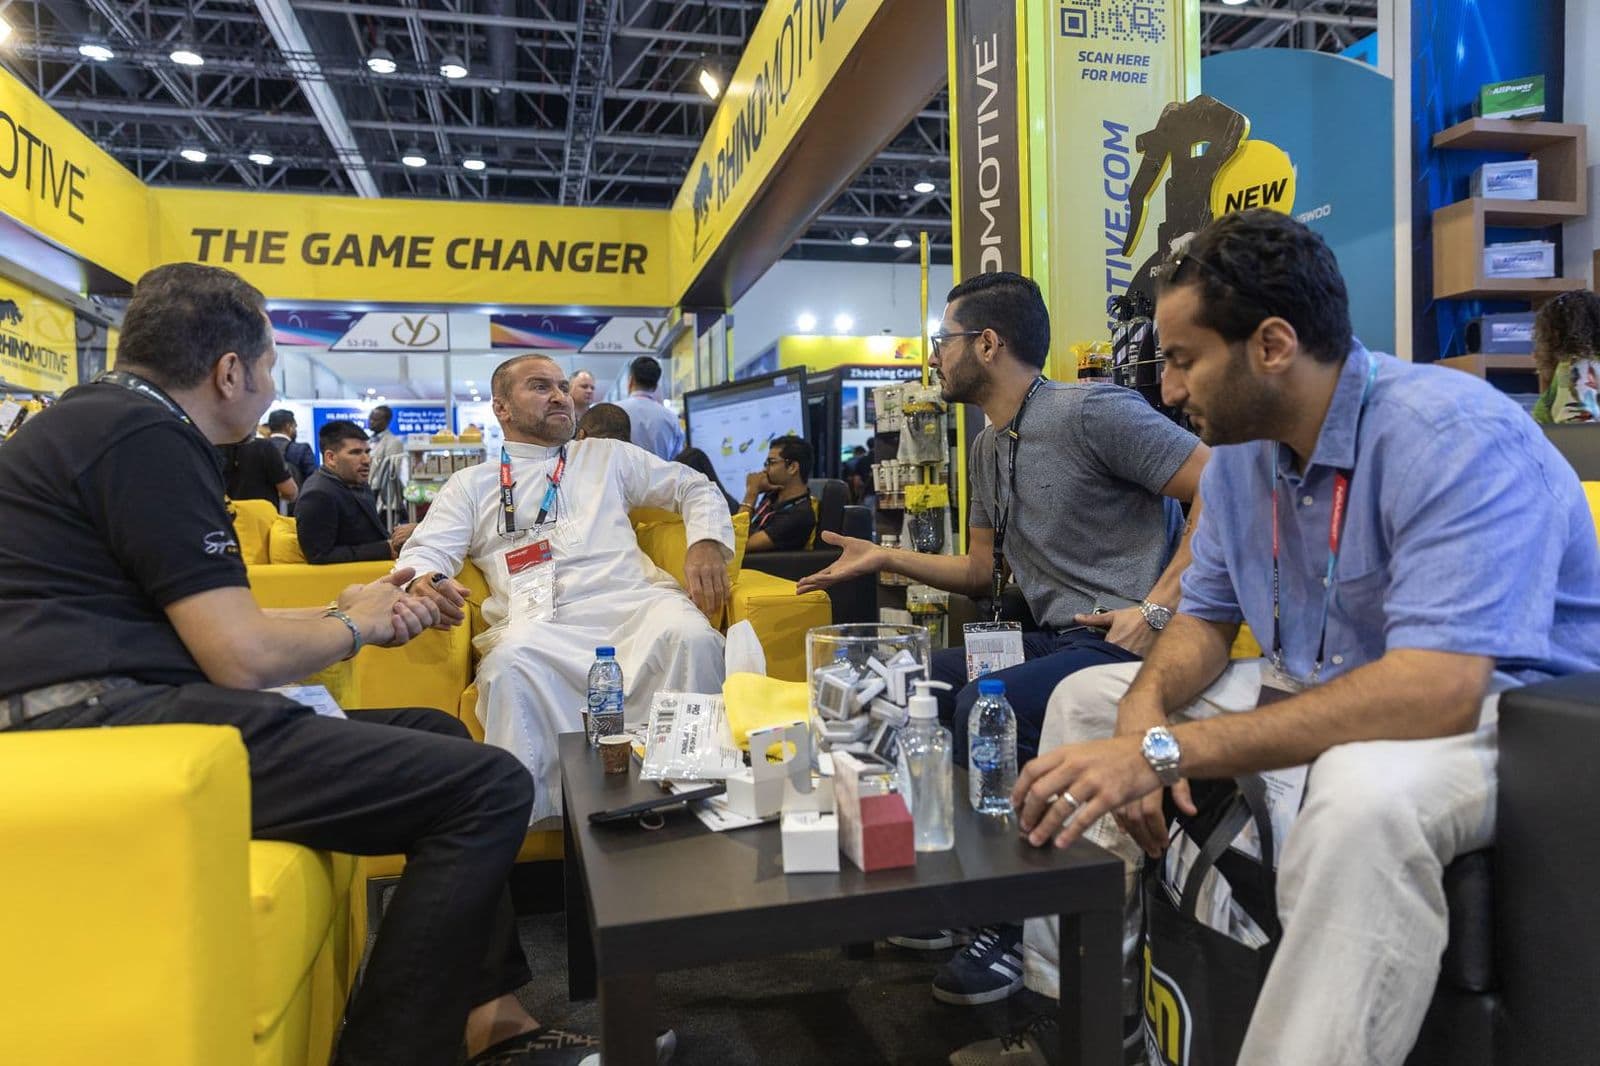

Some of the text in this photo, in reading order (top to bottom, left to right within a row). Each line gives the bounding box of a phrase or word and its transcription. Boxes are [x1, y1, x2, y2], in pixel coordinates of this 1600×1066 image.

[1078, 50, 1150, 67] SCAN HERE
[1081, 68, 1148, 84] FOR MORE
[1225, 178, 1288, 214] NEW
[191, 228, 648, 275] THE GAME CHANGER
